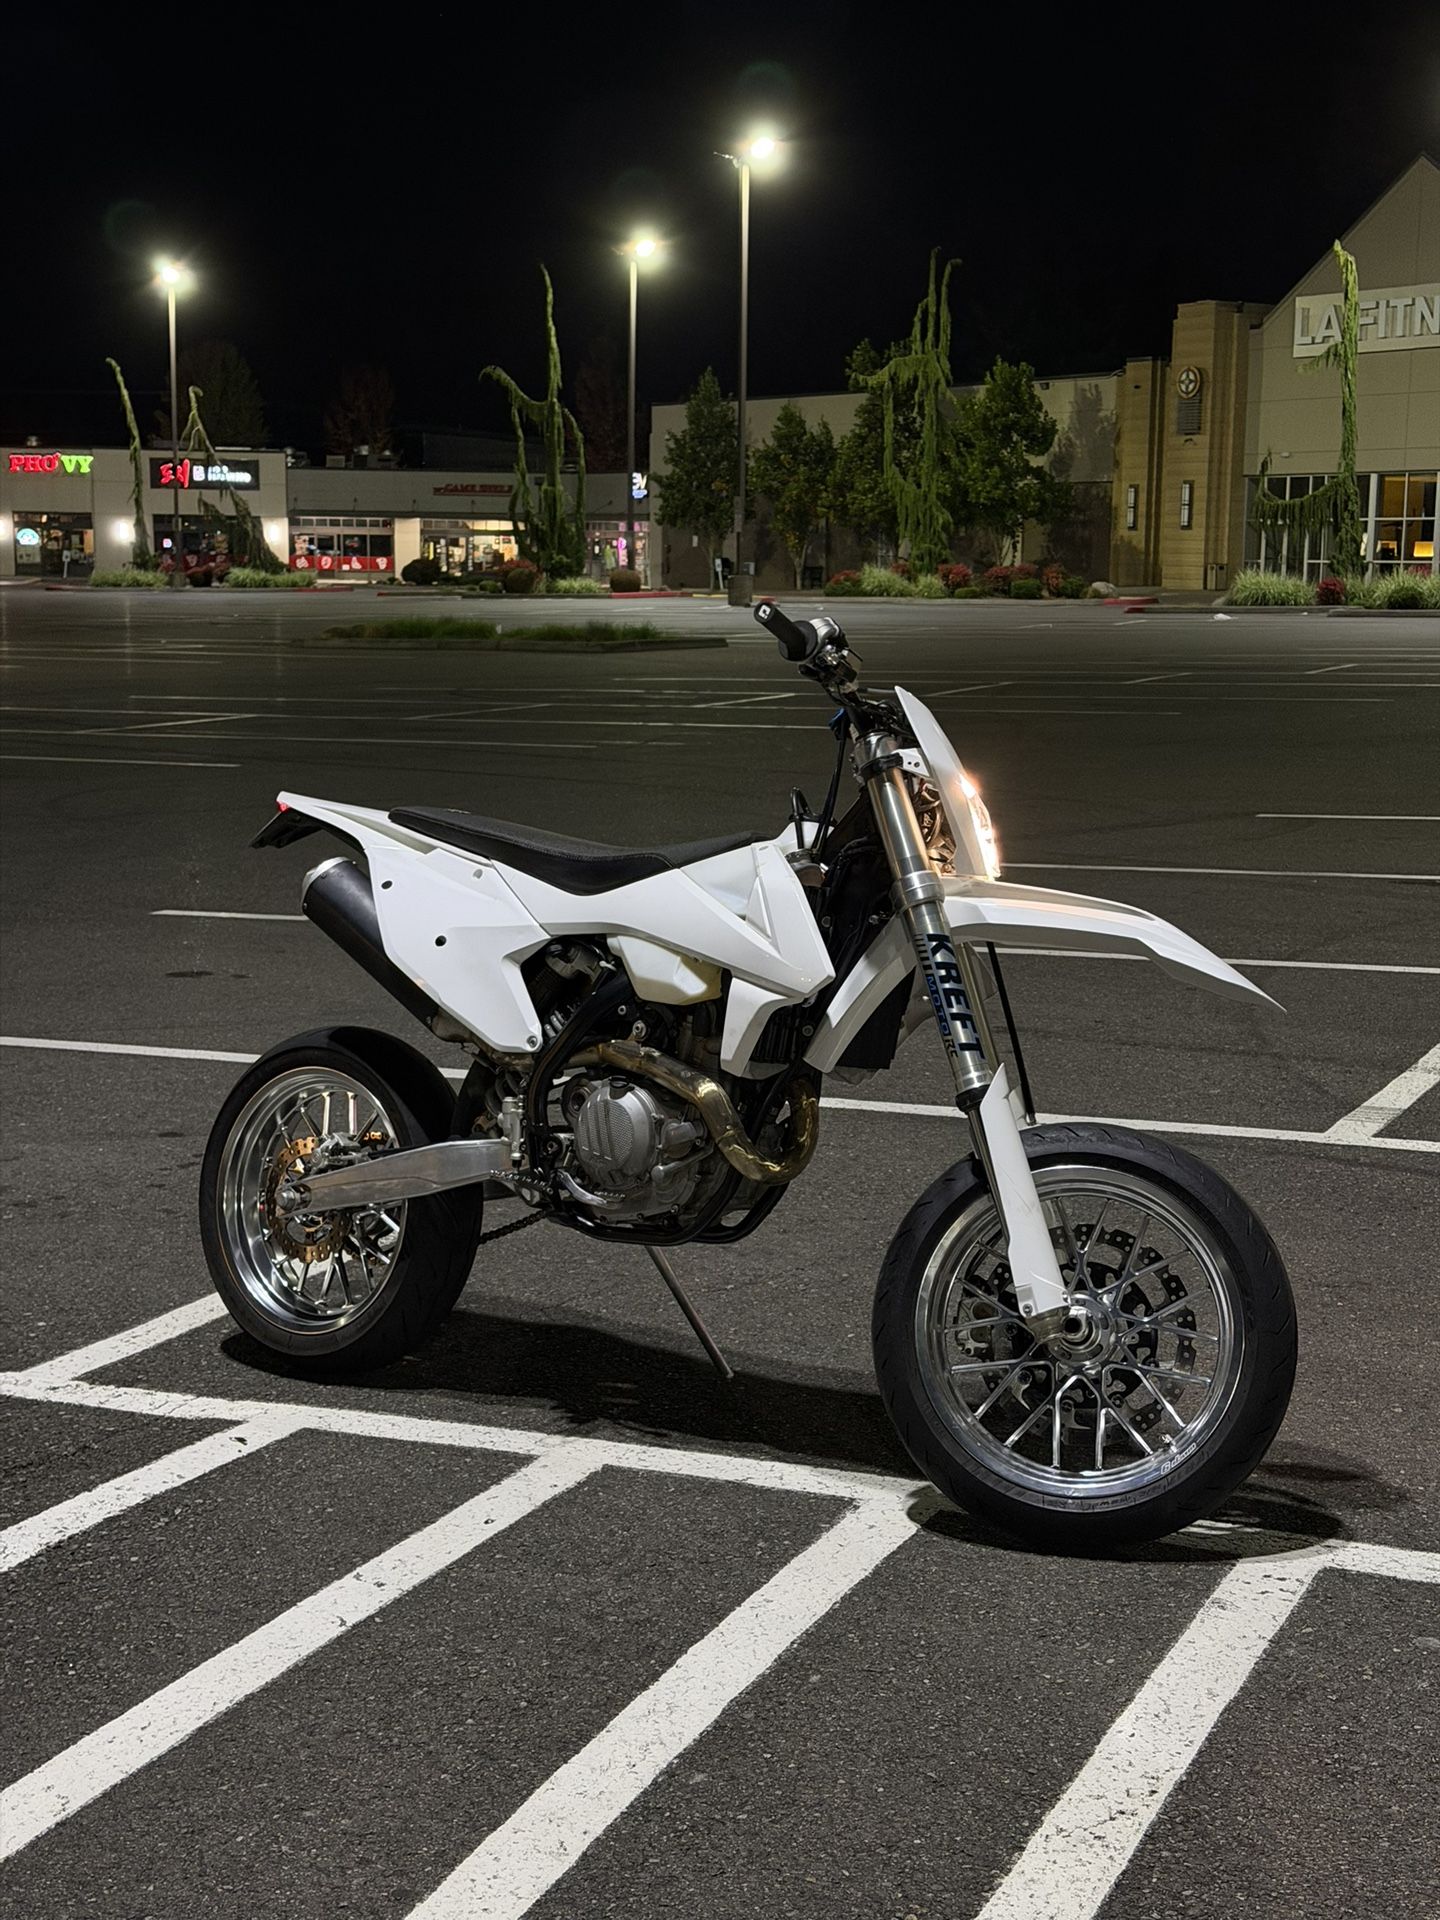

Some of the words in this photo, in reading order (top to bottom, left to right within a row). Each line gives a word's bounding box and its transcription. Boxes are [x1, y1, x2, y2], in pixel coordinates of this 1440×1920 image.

[1294, 303, 1343, 345] LA
[60, 455, 94, 473] VY
[926, 933, 986, 1060] KREFT
[926, 973, 952, 1037] MOTO
